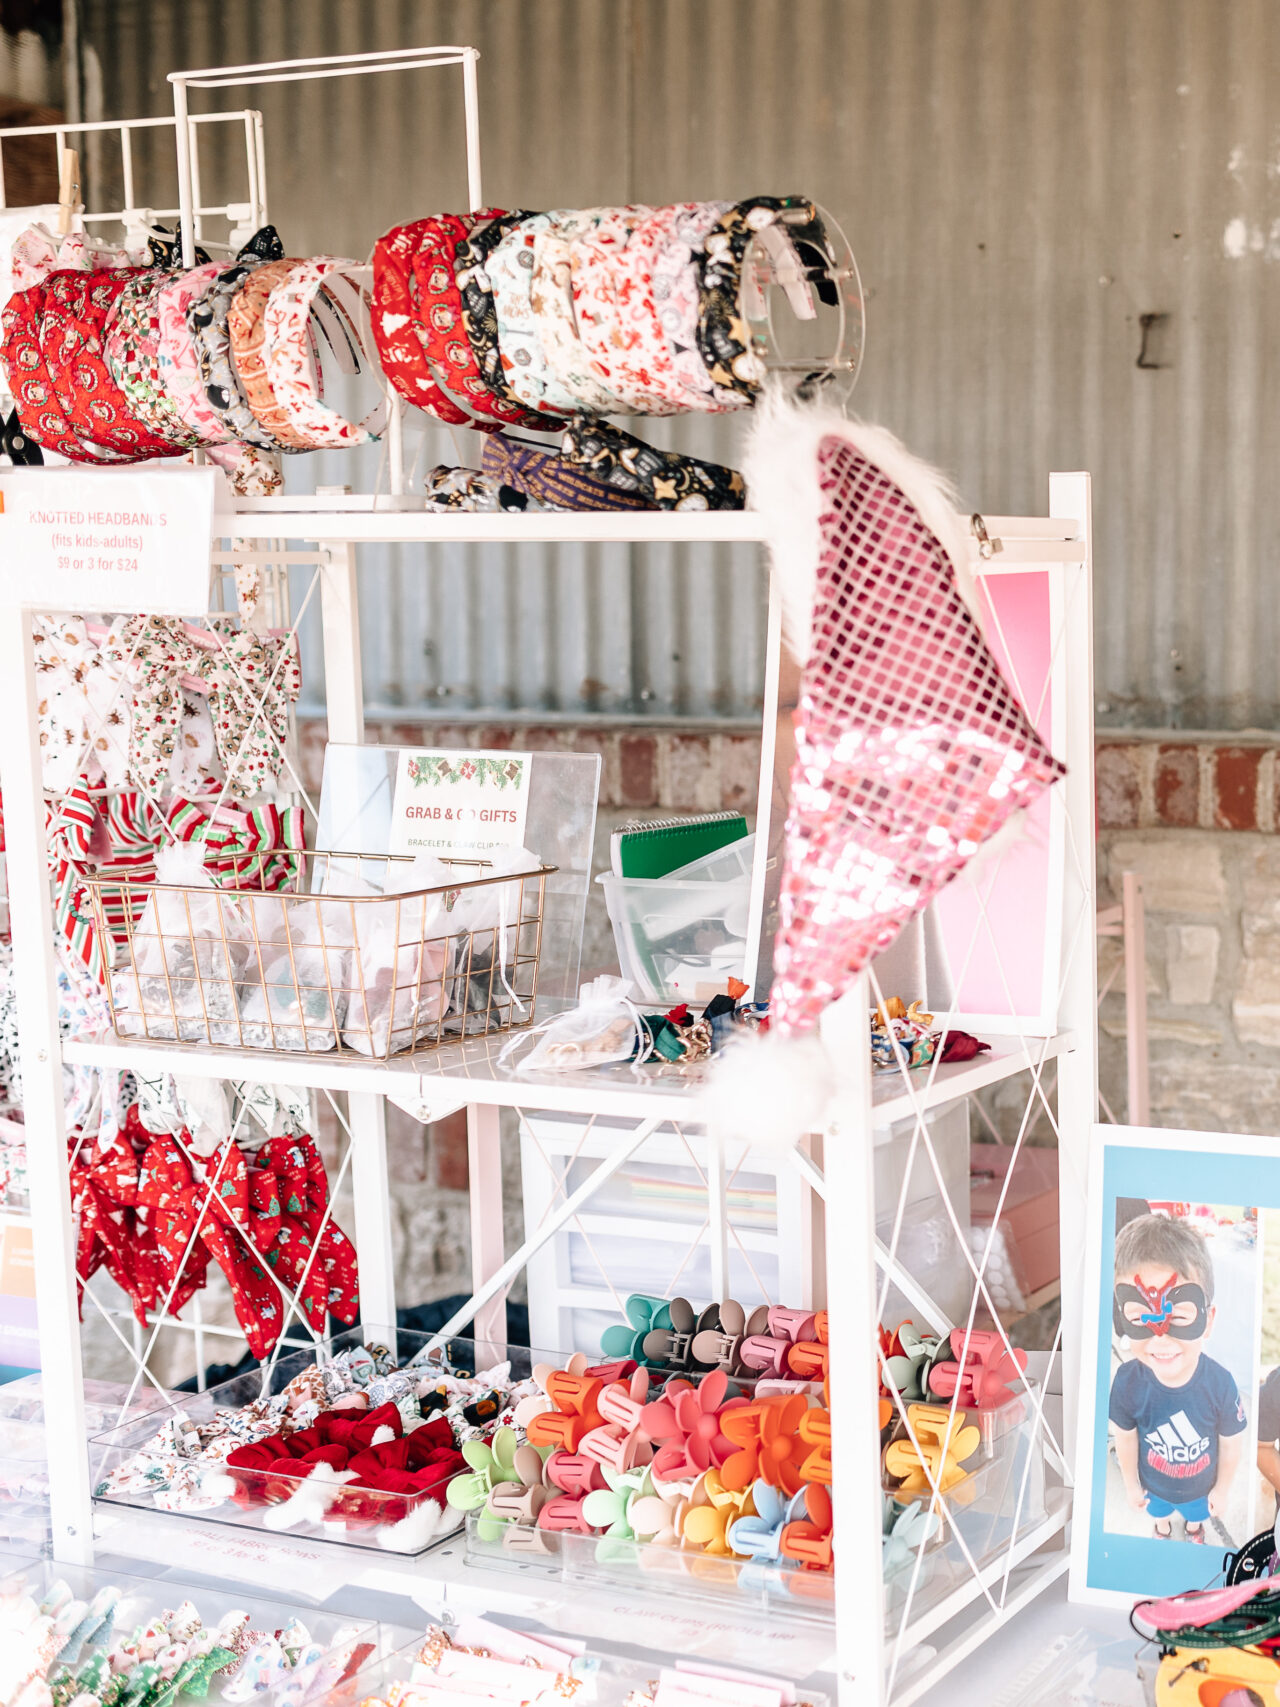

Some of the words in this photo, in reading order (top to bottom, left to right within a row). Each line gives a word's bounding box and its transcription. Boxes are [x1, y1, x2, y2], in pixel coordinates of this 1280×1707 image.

[29, 510, 86, 526] KNOTTED
[88, 512, 168, 527] HEADBANS
[50, 532, 73, 550] (fits
[74, 533, 144, 553] kids-adults)
[72, 558, 84, 570] or
[87, 556, 96, 571] 3
[97, 556, 115, 571] for
[116, 557, 139, 573] $24
[405, 806, 441, 820] GRAB
[444, 807, 454, 821] &
[480, 810, 518, 823] GIFTS
[407, 838, 446, 848] BRACELET
[1144, 1436, 1210, 1463] adidas
